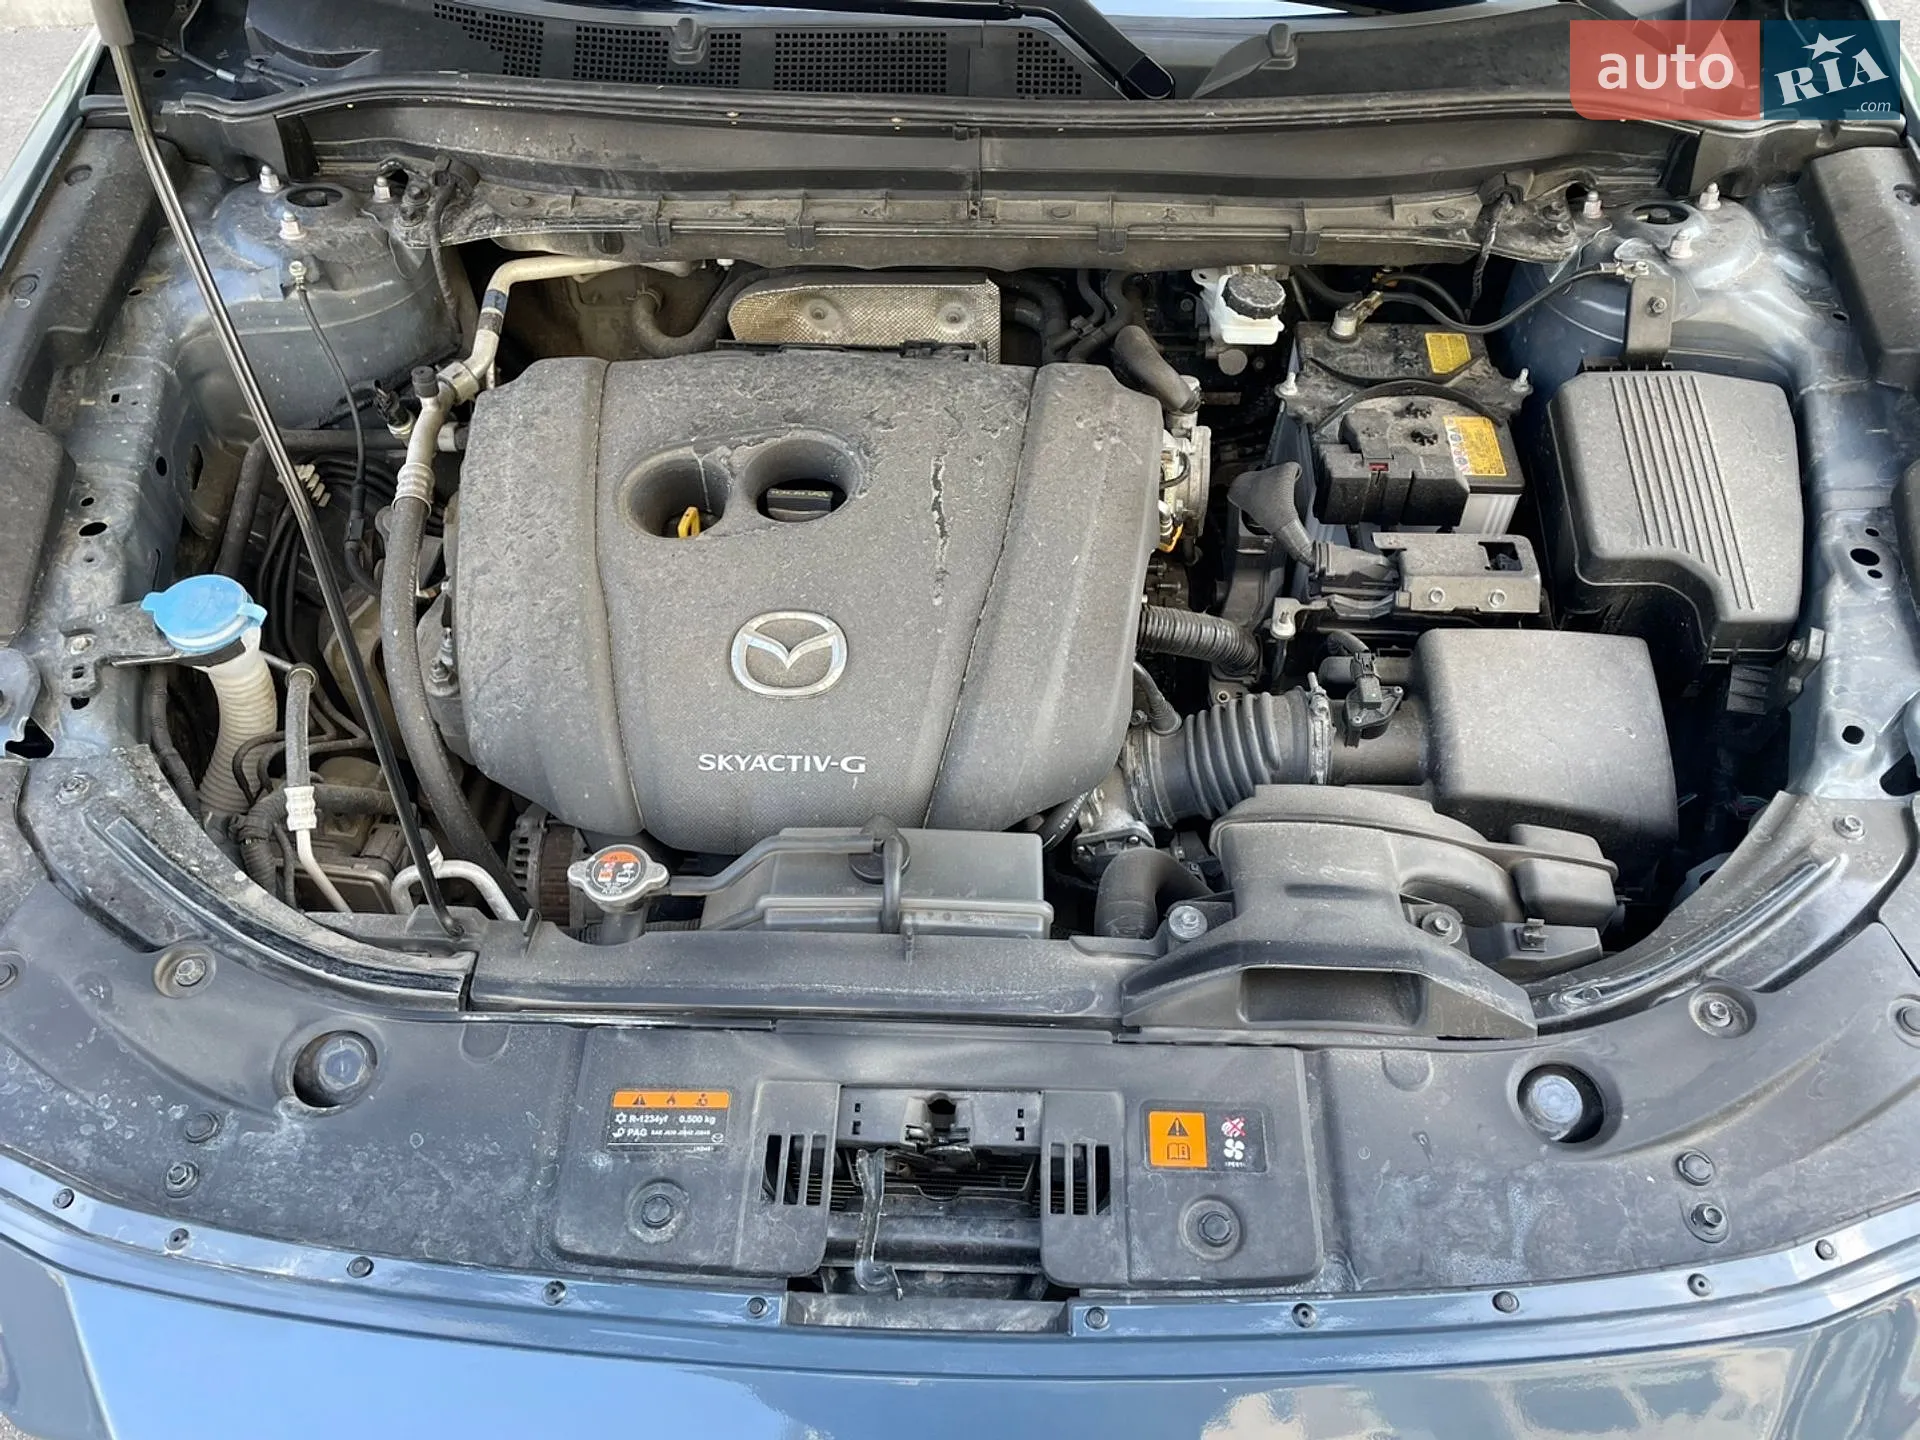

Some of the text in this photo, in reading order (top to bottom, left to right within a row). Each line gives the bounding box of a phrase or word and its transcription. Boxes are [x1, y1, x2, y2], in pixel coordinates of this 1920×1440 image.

[698, 753, 867, 774] SKYACTIV-G
[678, 1114, 703, 1124] 0.500
[704, 1114, 716, 1125] kg
